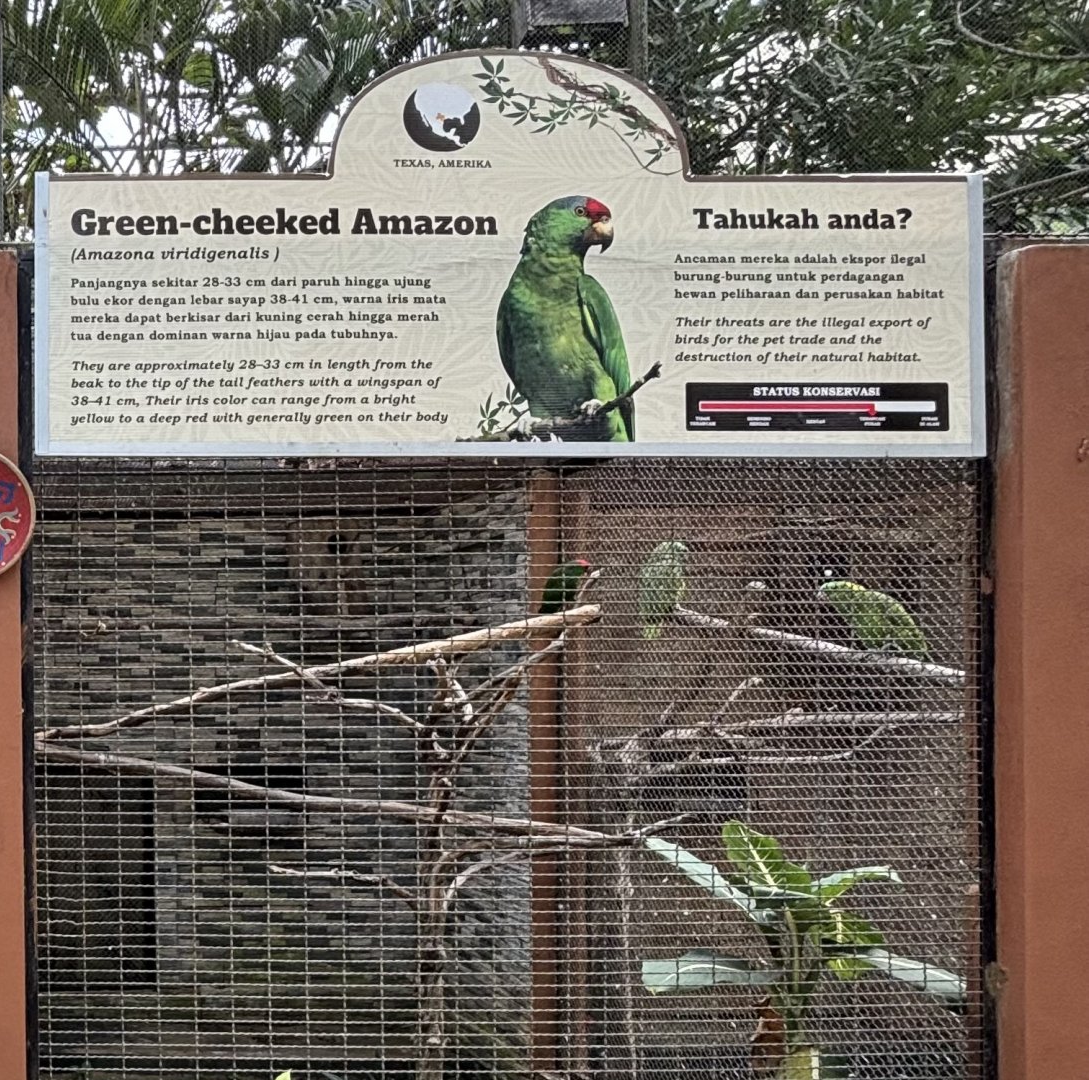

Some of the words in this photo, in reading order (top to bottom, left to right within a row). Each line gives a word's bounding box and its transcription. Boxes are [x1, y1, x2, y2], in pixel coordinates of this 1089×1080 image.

[393, 159, 435, 169] TEXAS,
[438, 159, 492, 169] AMERIKA
[71, 207, 341, 236] Green-cheeked
[350, 208, 498, 236] Amazon
[692, 208, 820, 230] Tahukah
[827, 207, 913, 230] anda?
[71, 248, 155, 264] (Amazona
[674, 254, 736, 264] Ancaman
[740, 253, 790, 264] mereka
[794, 253, 838, 264] adalah
[841, 254, 886, 267] ekspor
[890, 253, 926, 267] ilegal
[70, 277, 148, 291] Panjangnya
[151, 277, 199, 288] sekitar
[202, 276, 241, 287] 28-33
[245, 279, 266, 287] cm
[270, 276, 297, 287] dari
[301, 276, 341, 290] paruh
[344, 276, 390, 289] hingga
[393, 276, 432, 290] ujung
[673, 270, 772, 284] burung-burung
[776, 270, 816, 282] untuk
[820, 271, 904, 285] perdagangan
[70, 295, 100, 306] bulu
[103, 295, 134, 306] ekor
[138, 295, 186, 308] dengan
[190, 294, 224, 305] lebar
[227, 296, 266, 308] sayap
[270, 293, 309, 305] 38-41
[313, 296, 338, 306] cm,
[342, 296, 383, 304] warna
[387, 293, 409, 304] iris
[413, 294, 447, 304] mata
[674, 288, 717, 299] hewan
[720, 288, 791, 302] peliharaan
[795, 288, 819, 299] dan
[823, 288, 892, 302] perusakan
[896, 288, 945, 299] habitat
[70, 312, 120, 323] mereka
[124, 312, 162, 326] dapat
[165, 312, 221, 323] berkisar
[224, 311, 251, 322] dari
[255, 311, 303, 325] kuning
[306, 311, 344, 322] cerah
[348, 310, 393, 325] hingga
[397, 311, 439, 322] merah
[675, 316, 712, 327] Their
[715, 316, 765, 328] threats
[768, 319, 792, 328] are
[795, 317, 818, 328] the
[822, 317, 865, 330] illegal
[868, 317, 913, 330] export
[916, 316, 932, 330] of
[70, 331, 93, 341] tua
[96, 330, 145, 344] dengan
[149, 329, 208, 341] dominan
[211, 331, 252, 340] warna
[256, 329, 291, 342] hijau
[294, 328, 327, 342] pada
[330, 328, 398, 342] tubuhnya.
[674, 334, 710, 345] birds
[711, 333, 734, 347] for
[737, 334, 760, 345] the
[761, 335, 785, 347] pet
[789, 334, 826, 345] trade
[829, 334, 857, 345] and
[860, 334, 882, 345] the
[674, 351, 752, 362] destruction
[756, 351, 772, 365] of
[774, 351, 808, 362] their
[811, 351, 863, 362] natural
[867, 351, 921, 362] habitat.
[753, 386, 800, 397] STATUS
[802, 386, 880, 397] KONSERVASI
